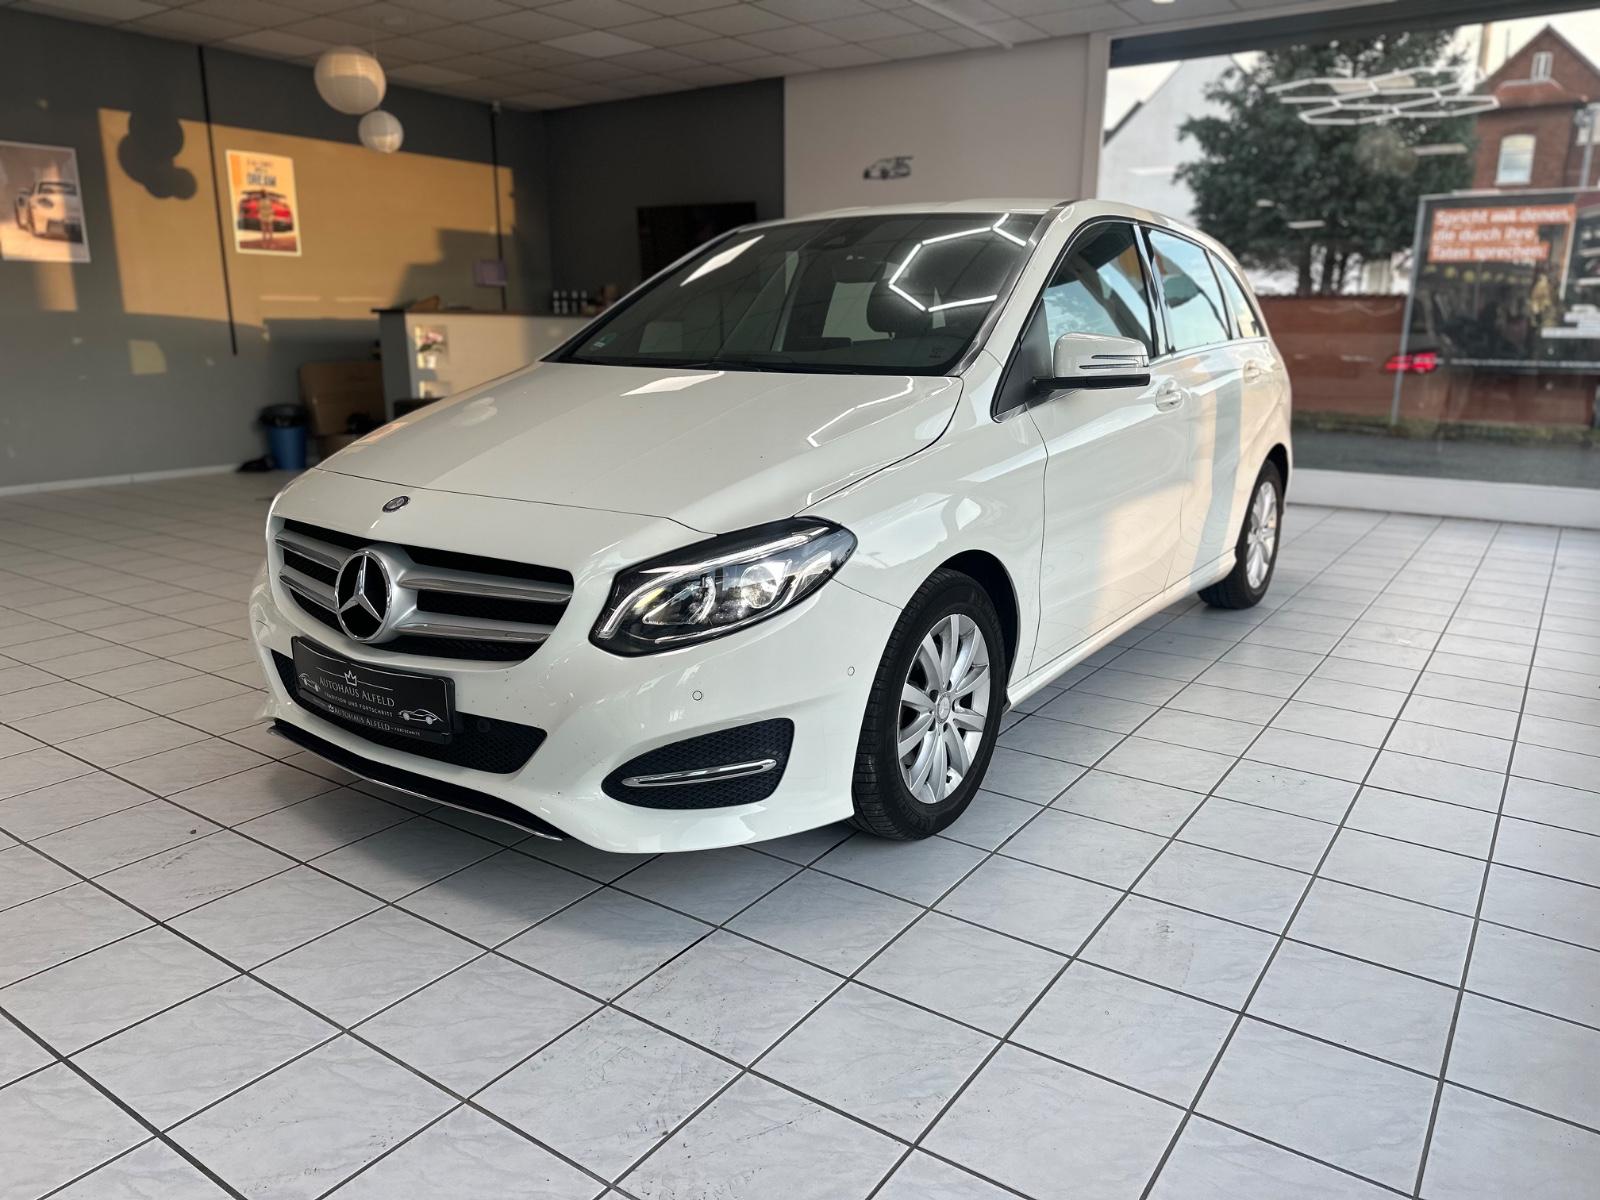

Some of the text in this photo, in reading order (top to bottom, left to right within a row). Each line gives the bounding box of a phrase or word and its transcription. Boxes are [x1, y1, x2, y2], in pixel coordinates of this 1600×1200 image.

[319, 677, 395, 707] AUTOHAUS ALFELD
[335, 707, 365, 725] AUTOHAUS
[366, 718, 391, 731] ALFELD
